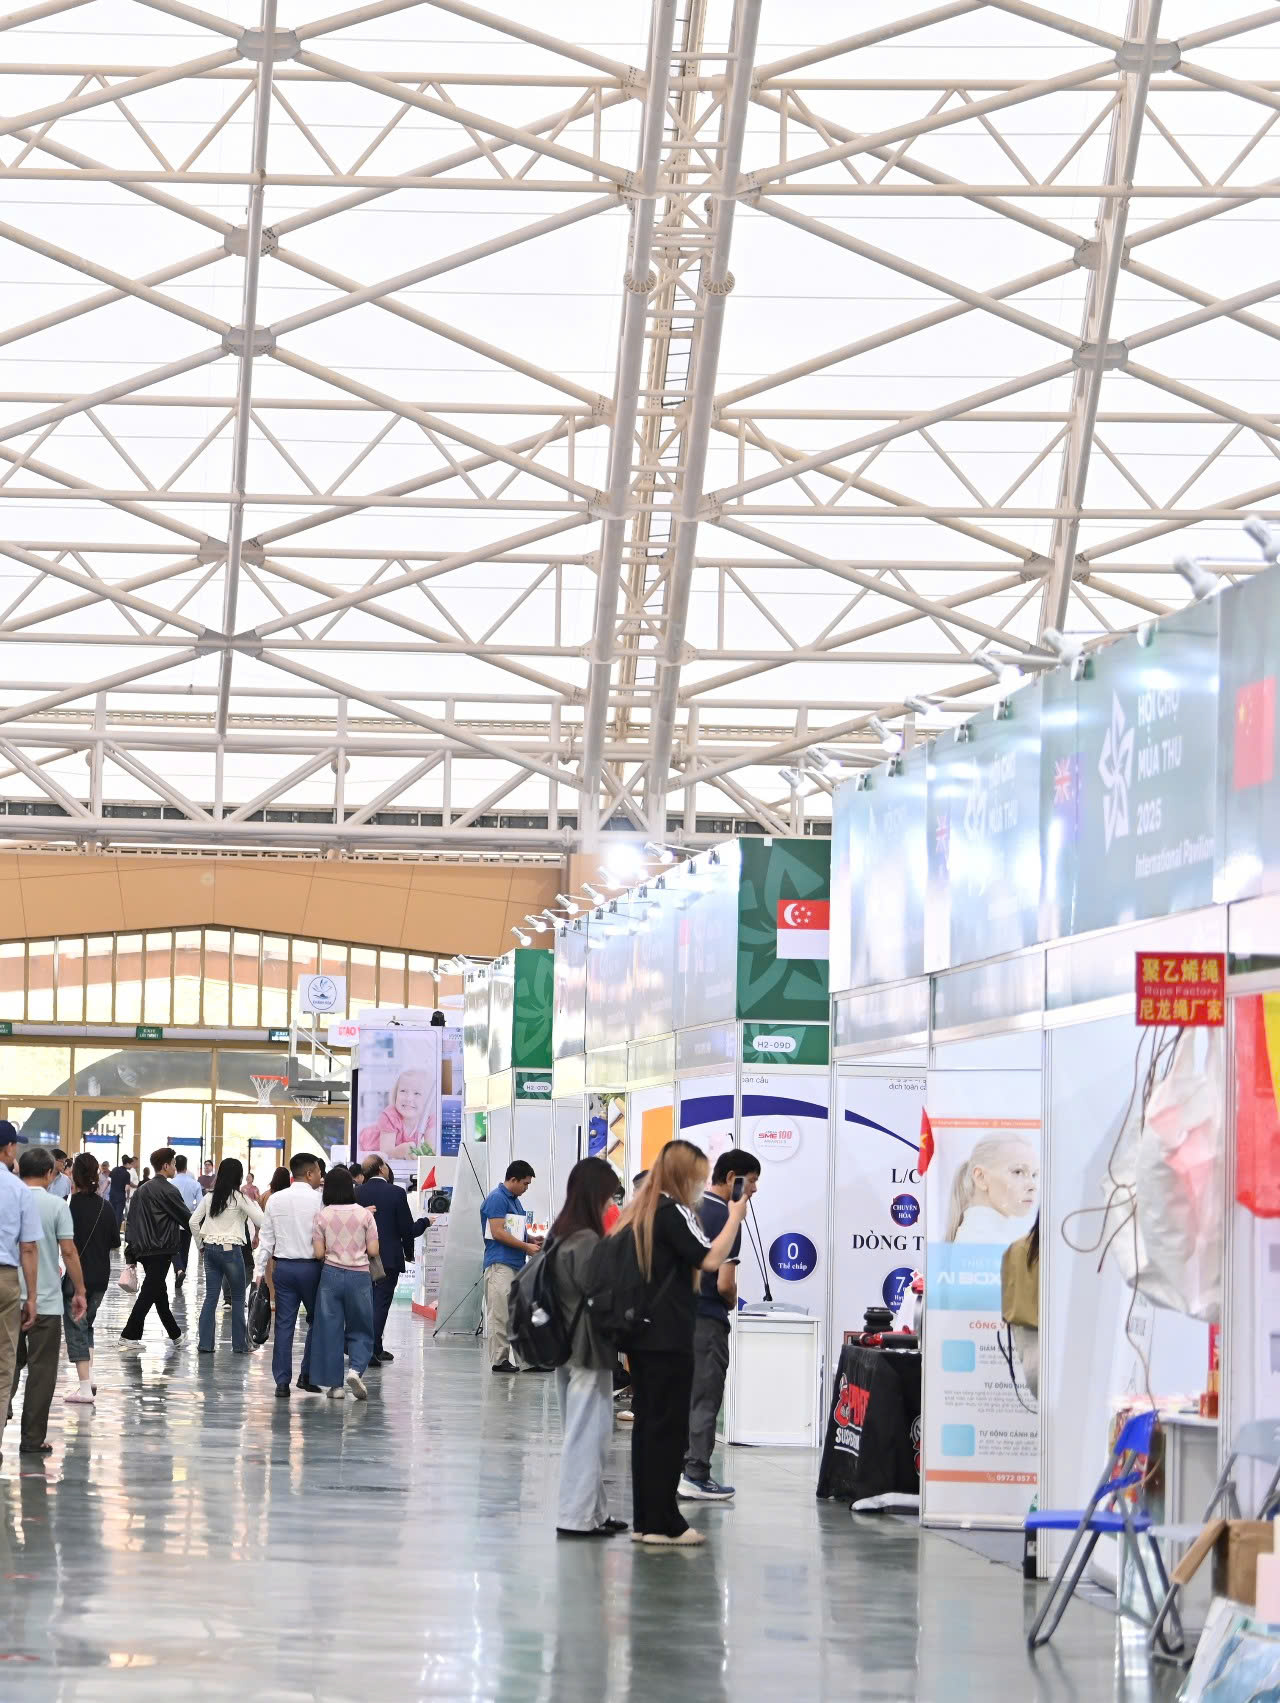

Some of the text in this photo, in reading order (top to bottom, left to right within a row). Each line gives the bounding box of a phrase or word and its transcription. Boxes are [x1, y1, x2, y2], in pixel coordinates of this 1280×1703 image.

[1138, 735, 1182, 781] MÙA THU
[1137, 797, 1162, 836] 2025
[1142, 958, 1219, 983] 聚乙烯绳
[1144, 985, 1218, 997] Rope Factory
[1140, 997, 1222, 1021] 尼龙绳厂家
[889, 1083, 904, 1091] dịch
[778, 1130, 792, 1140] 100
[891, 1168, 921, 1184] L/C
[852, 1230, 908, 1250] DÒNG
[788, 1243, 798, 1260] 0
[959, 1272, 1001, 1285] BOX
[969, 1320, 997, 1329] CÔNG
